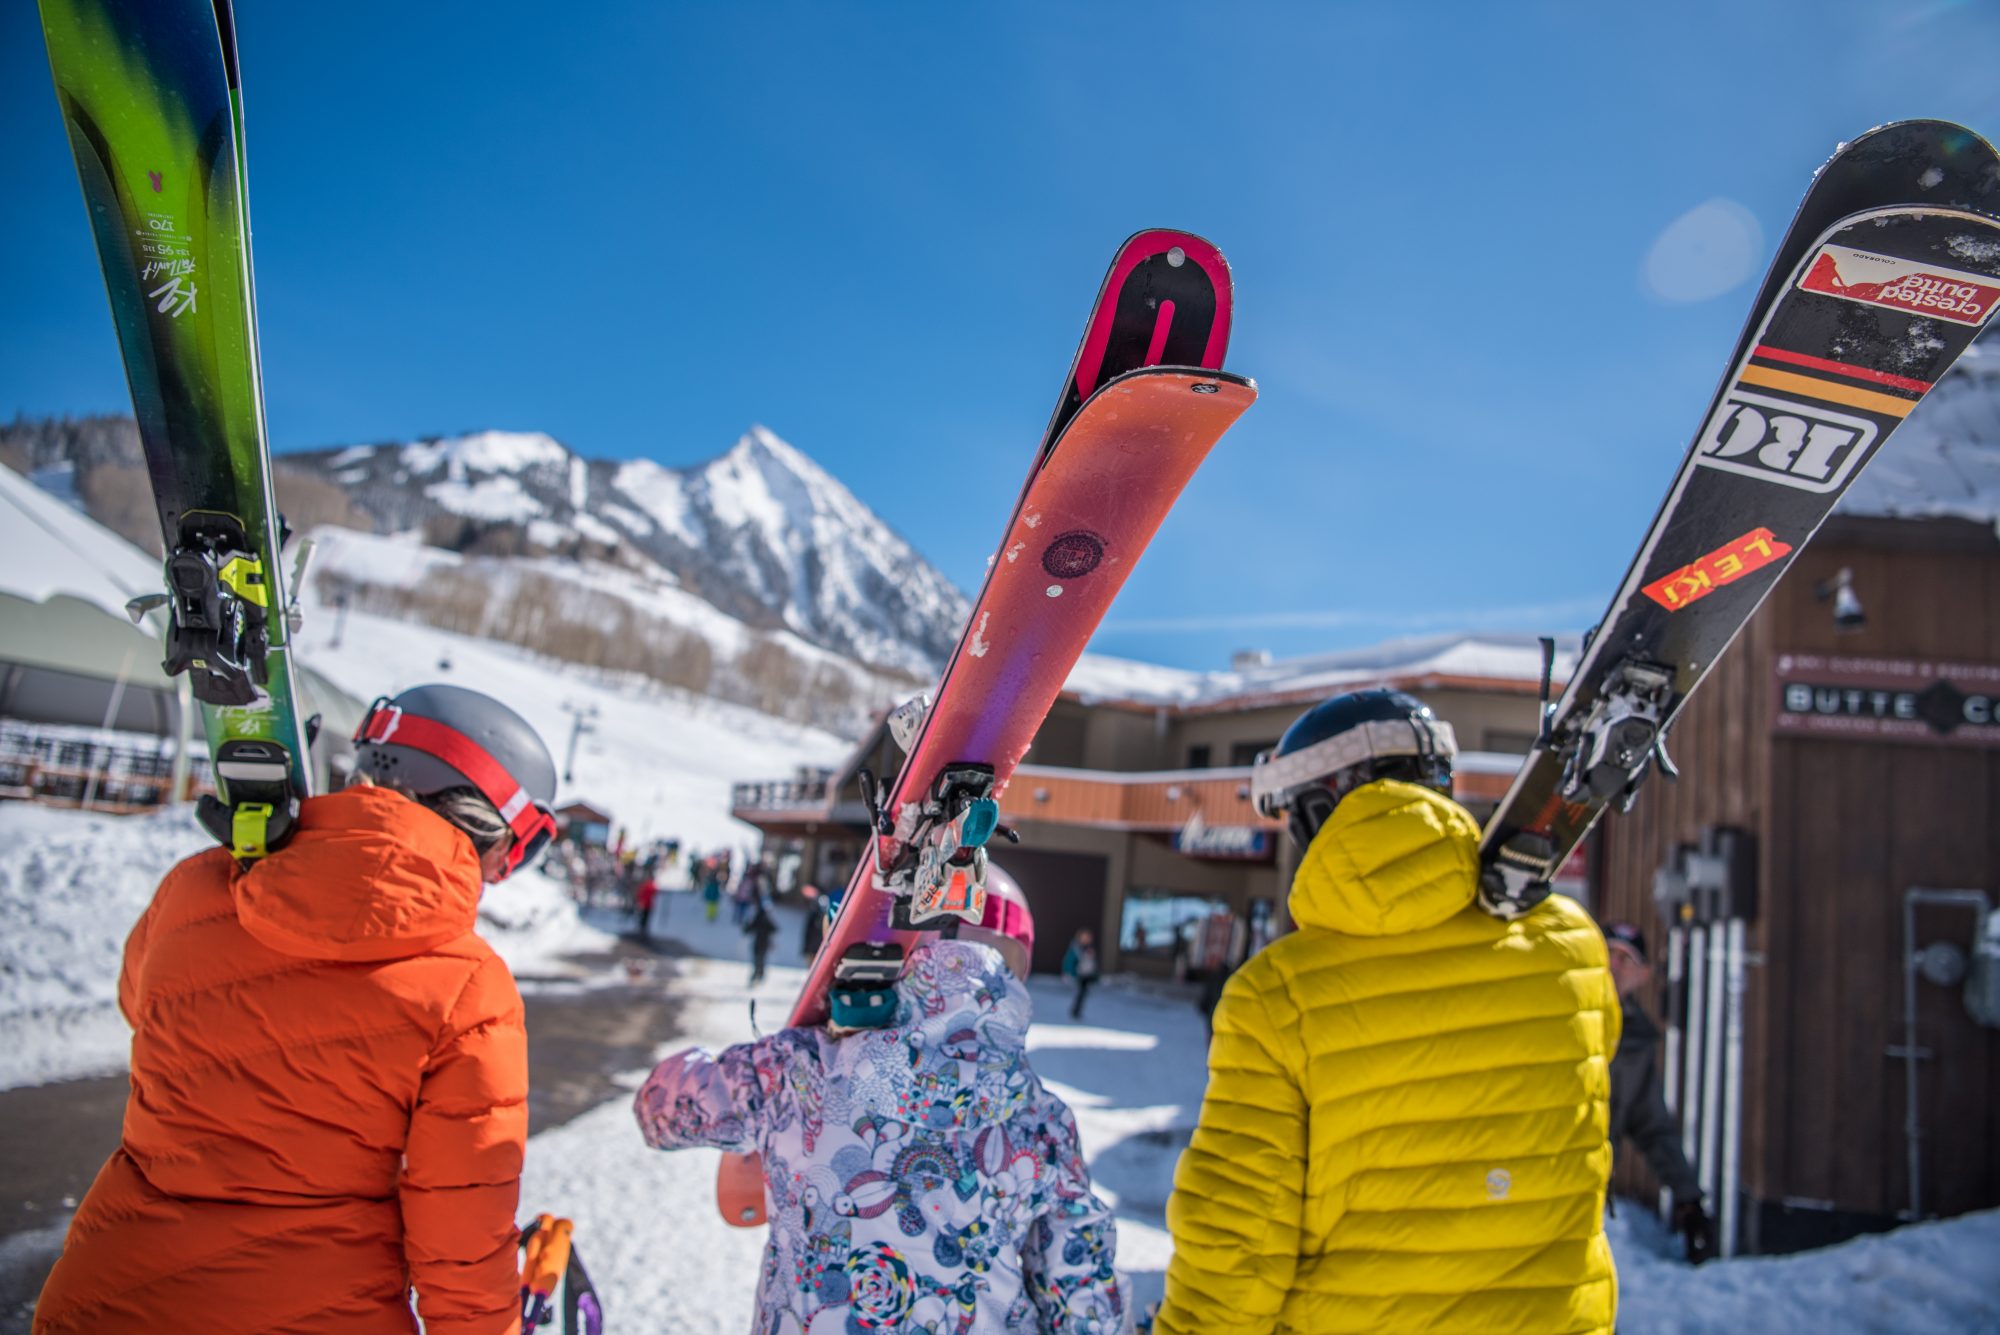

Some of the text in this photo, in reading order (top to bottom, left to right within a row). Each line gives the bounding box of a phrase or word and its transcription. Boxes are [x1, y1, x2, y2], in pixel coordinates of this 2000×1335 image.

[149, 219, 175, 232] 170
[142, 244, 156, 253] 115
[157, 243, 174, 256] 95
[1853, 252, 1896, 265] COLORADO
[148, 277, 198, 317] K2
[1877, 285, 1981, 315] crested
[1903, 274, 1978, 301] butte
[1663, 538, 1772, 604] LEKI
[1786, 683, 2000, 724] BUTTE C
